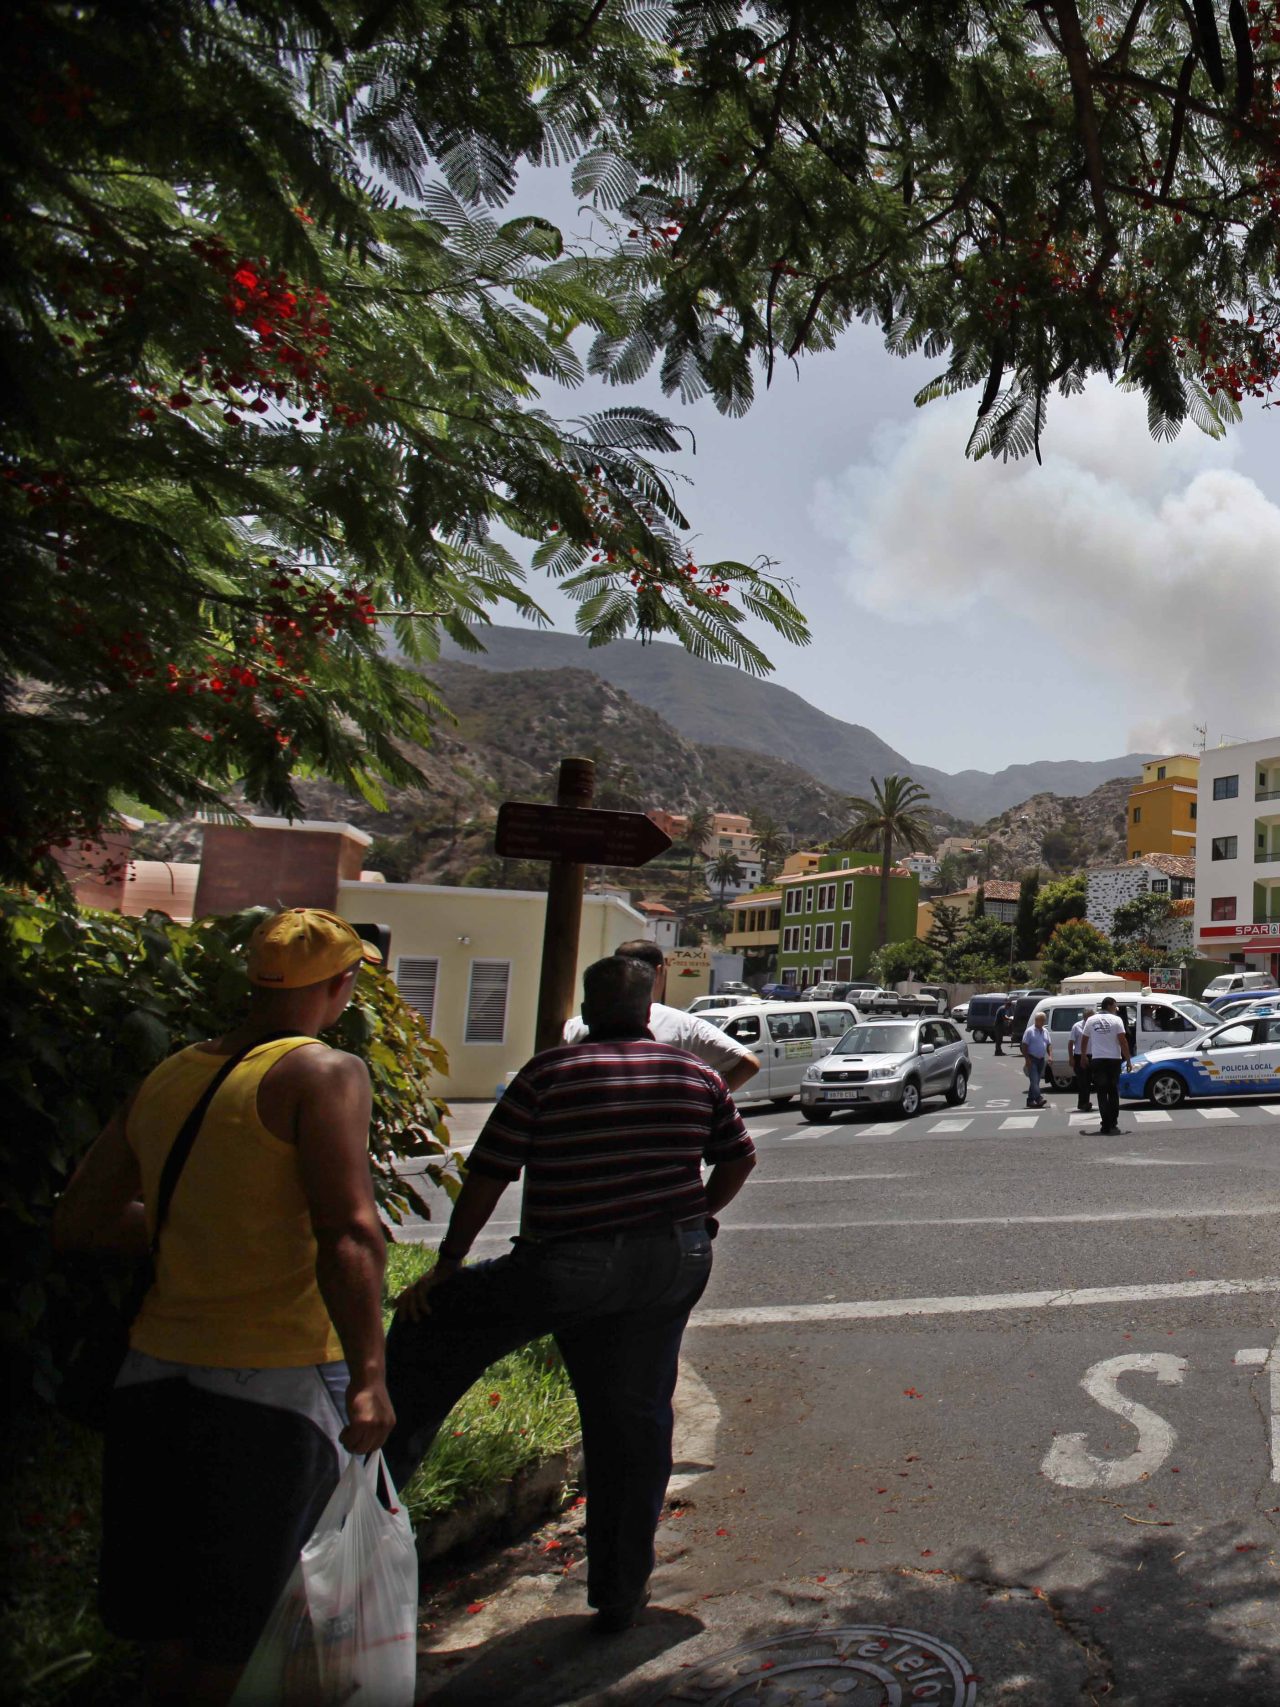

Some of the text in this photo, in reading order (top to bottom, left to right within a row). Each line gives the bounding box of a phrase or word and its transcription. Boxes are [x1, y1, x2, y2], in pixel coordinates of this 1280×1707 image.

[1235, 925, 1269, 935] SPAR
[674, 951, 706, 959] TAXI
[1221, 1063, 1273, 1072] POLICIA LOCAL
